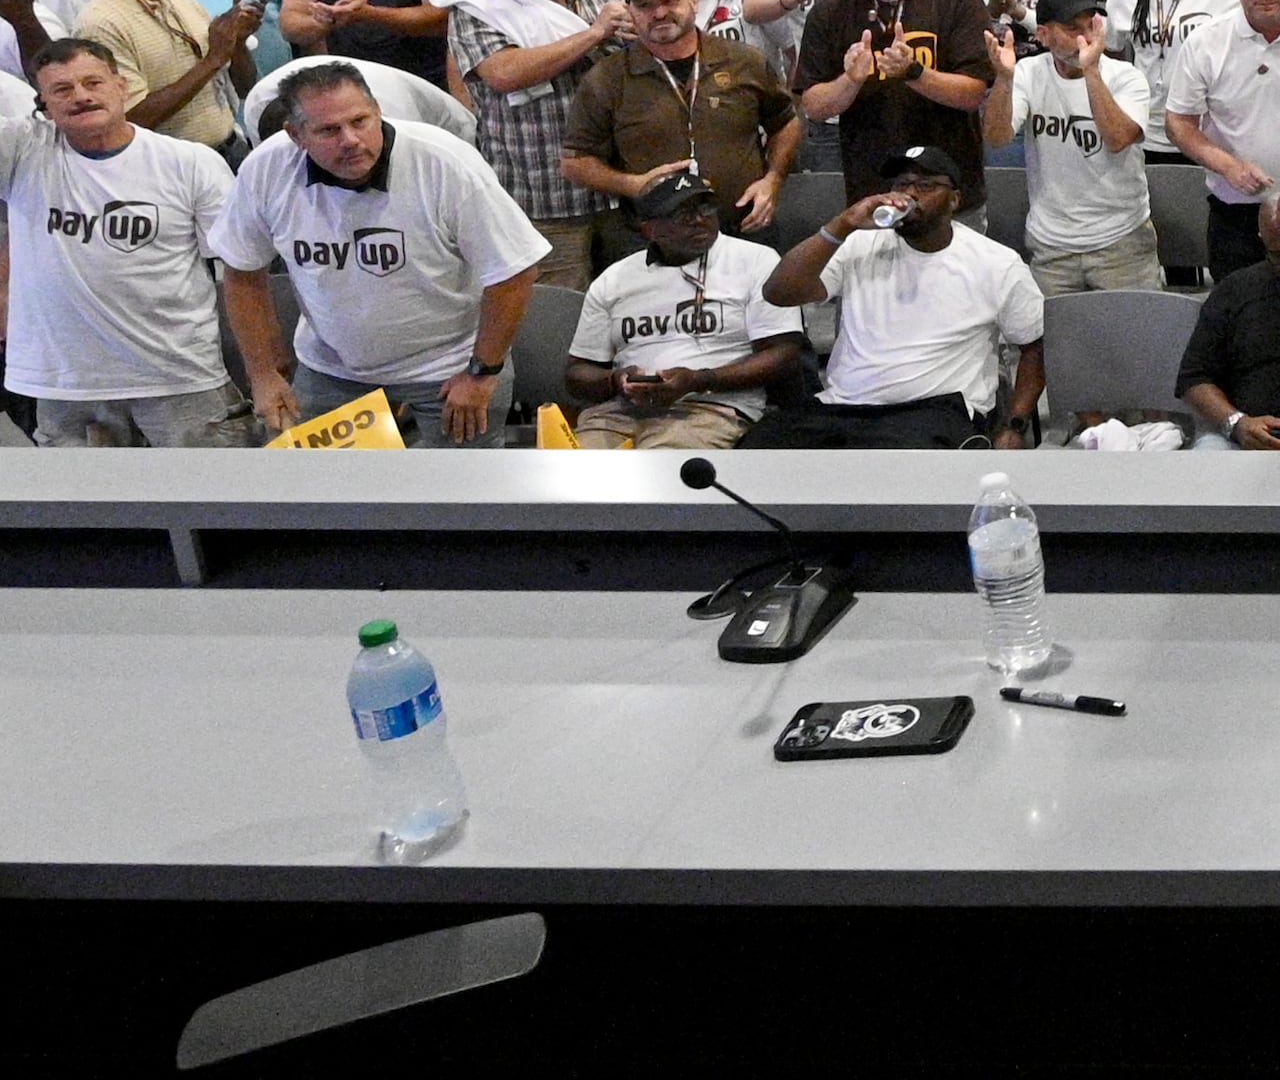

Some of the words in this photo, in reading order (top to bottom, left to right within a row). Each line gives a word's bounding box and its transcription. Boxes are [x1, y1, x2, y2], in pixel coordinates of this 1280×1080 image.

[1032, 114, 1071, 139] pay
[1072, 129, 1097, 150] up
[47, 203, 98, 244] pay
[110, 210, 154, 246] up
[293, 238, 350, 271] pay
[358, 241, 400, 273] up
[621, 316, 670, 343] pay
[678, 308, 718, 337] up
